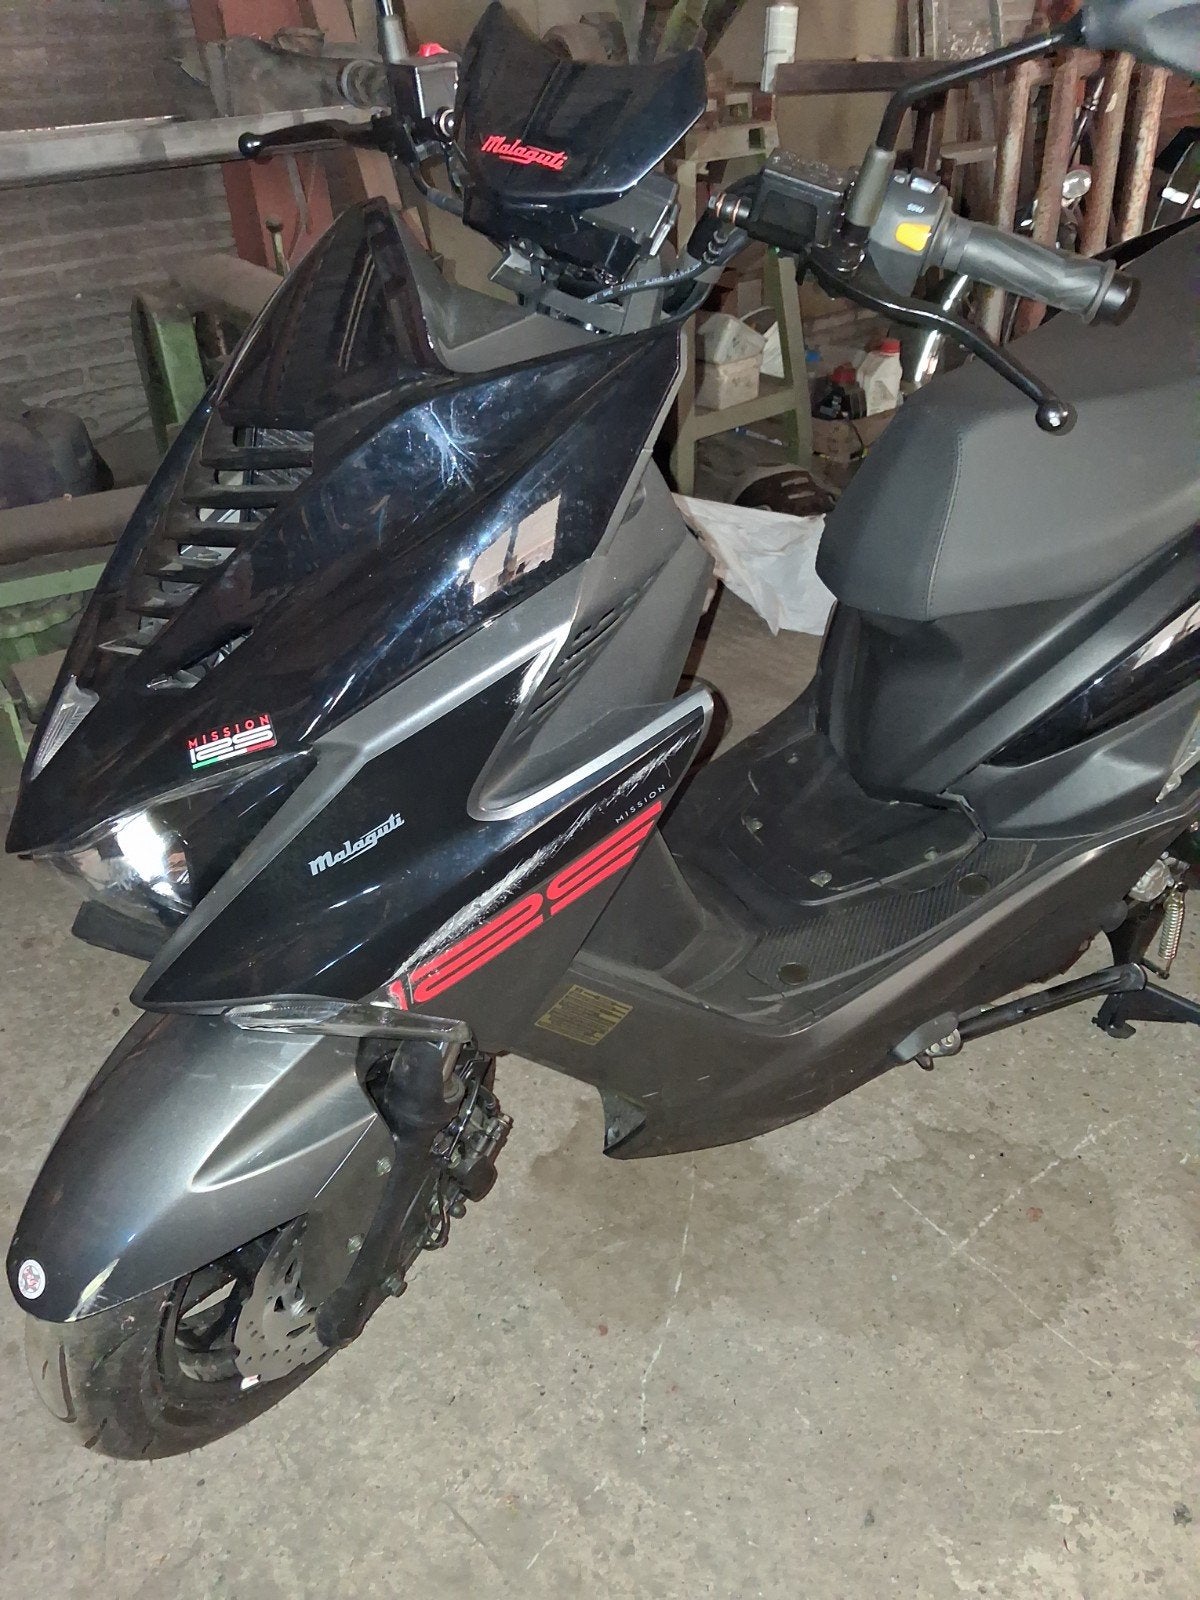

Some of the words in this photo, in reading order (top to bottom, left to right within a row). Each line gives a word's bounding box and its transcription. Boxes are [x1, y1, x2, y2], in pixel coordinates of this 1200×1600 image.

[481, 135, 568, 170] Malaguti
[188, 714, 270, 750] MISSION
[190, 724, 274, 764] 125
[615, 784, 666, 824] MISSION
[308, 813, 405, 876] Malaguti
[389, 800, 663, 1010] 125
